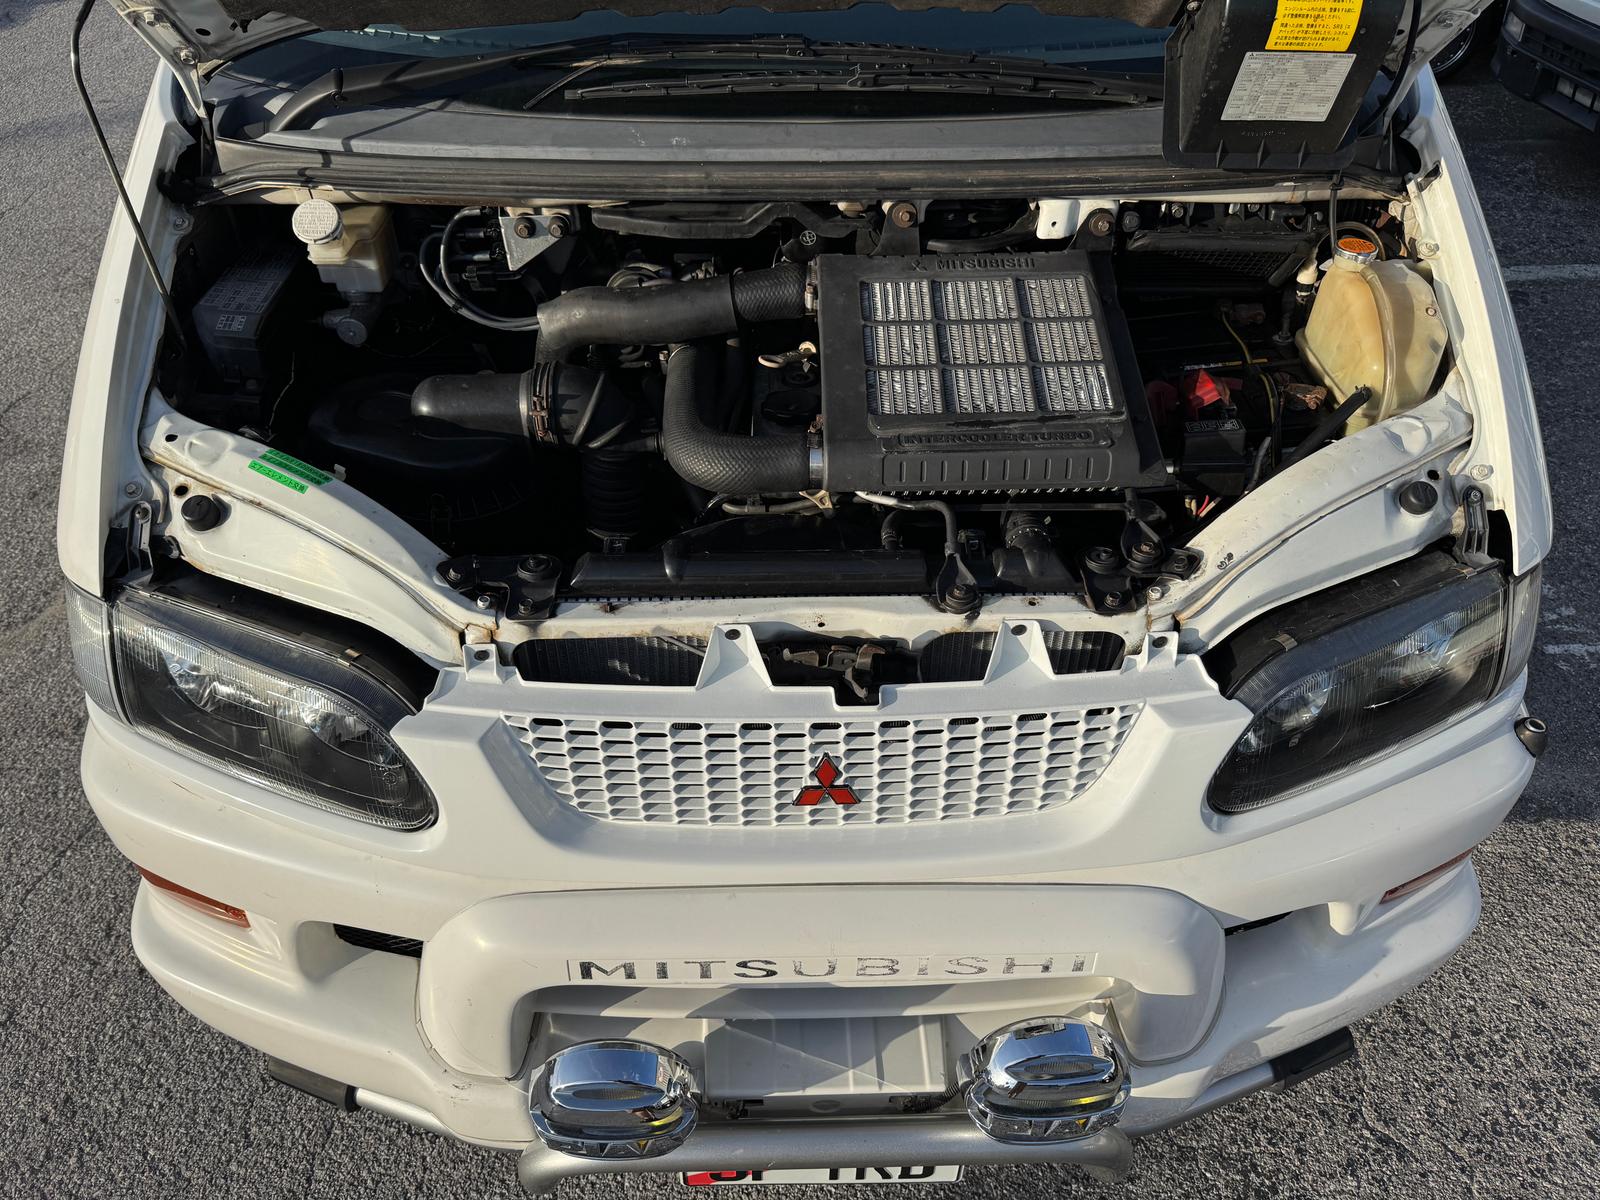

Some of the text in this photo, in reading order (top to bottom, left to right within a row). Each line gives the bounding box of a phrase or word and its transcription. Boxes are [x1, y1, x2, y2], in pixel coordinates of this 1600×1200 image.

[936, 257, 1036, 271] MITSUBISHI
[904, 430, 1091, 445] INTERCOOLER TURBO
[580, 955, 1087, 979] MITSUBISHI
